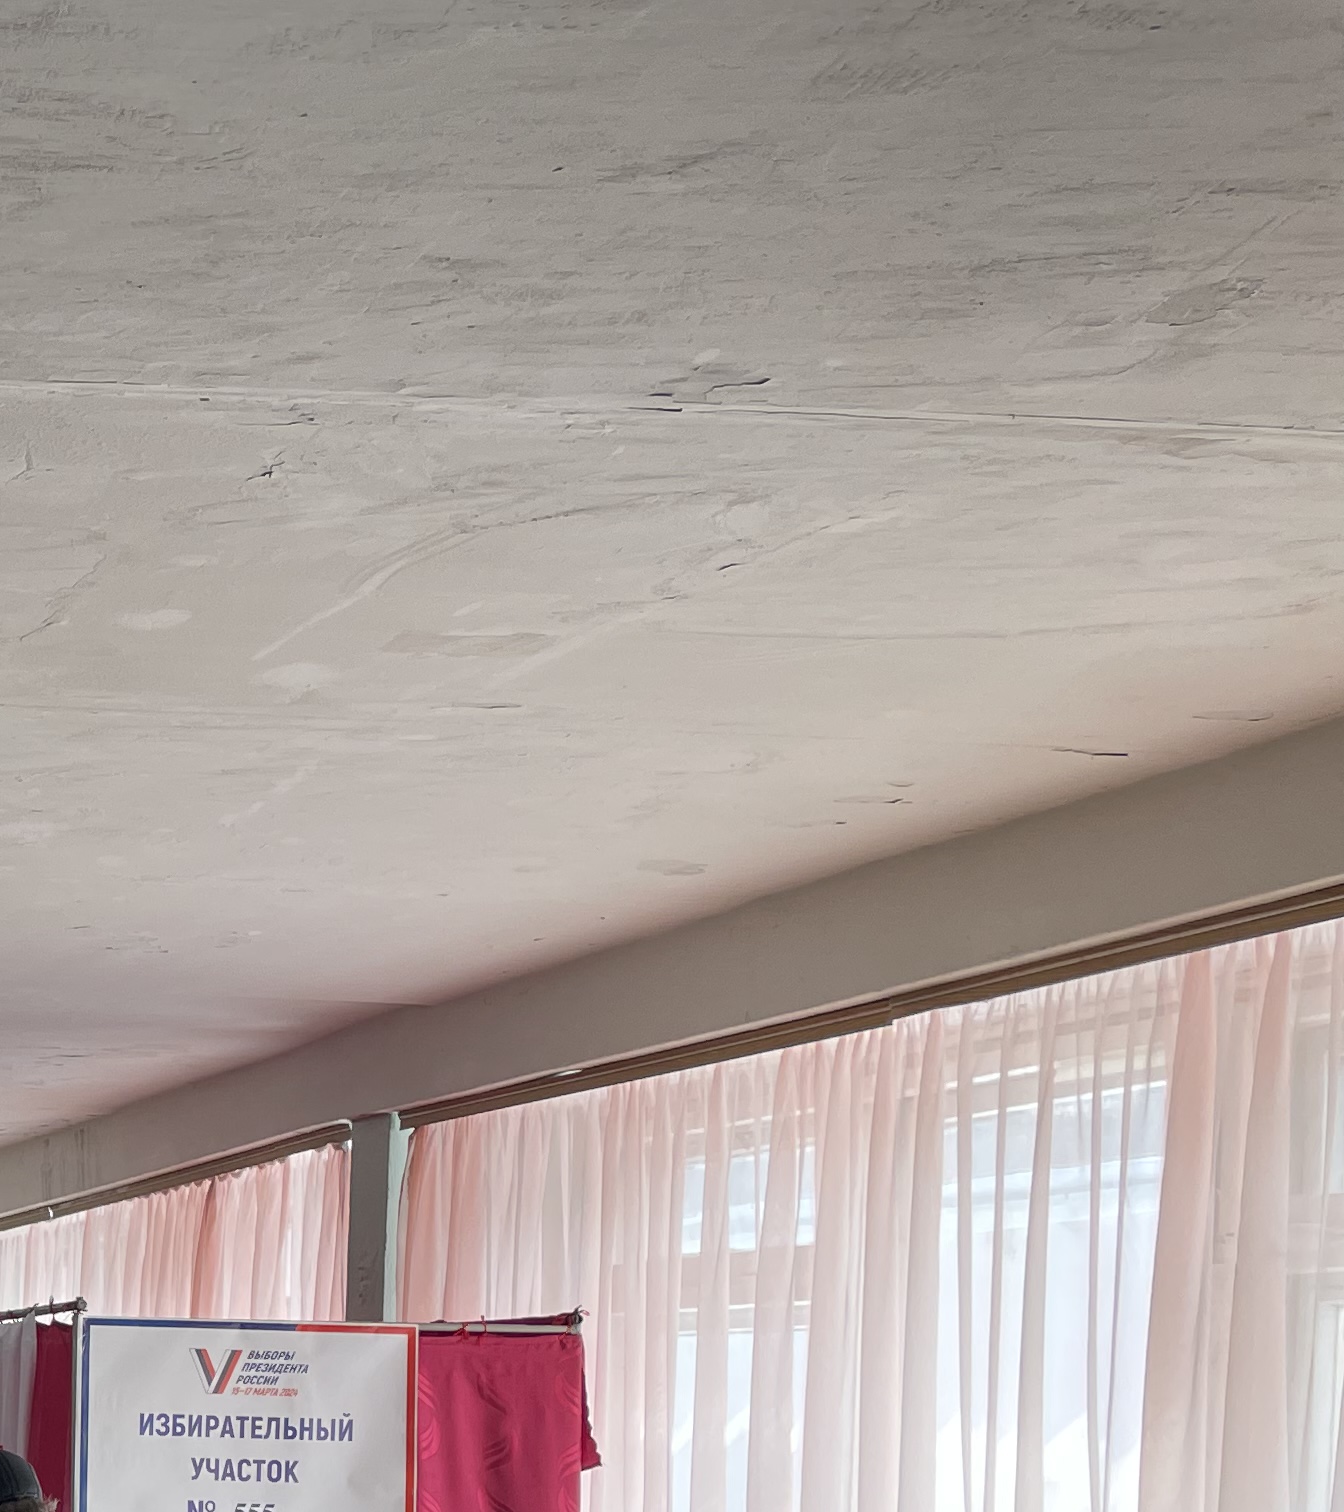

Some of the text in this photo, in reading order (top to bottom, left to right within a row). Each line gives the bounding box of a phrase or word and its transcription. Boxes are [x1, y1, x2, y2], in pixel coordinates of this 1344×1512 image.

[247, 1350, 296, 1361] ВЫБОРЫ
[241, 1363, 310, 1375] ПРЕЗИДЕНТА
[236, 1375, 280, 1386] РОССИИ
[253, 1388, 279, 1397] МАРТА
[279, 1388, 299, 1398] 2024
[139, 1413, 354, 1441] ИЗБИРАТЕЛЬНЫЙ
[191, 1457, 299, 1483] УЧАСТОК
